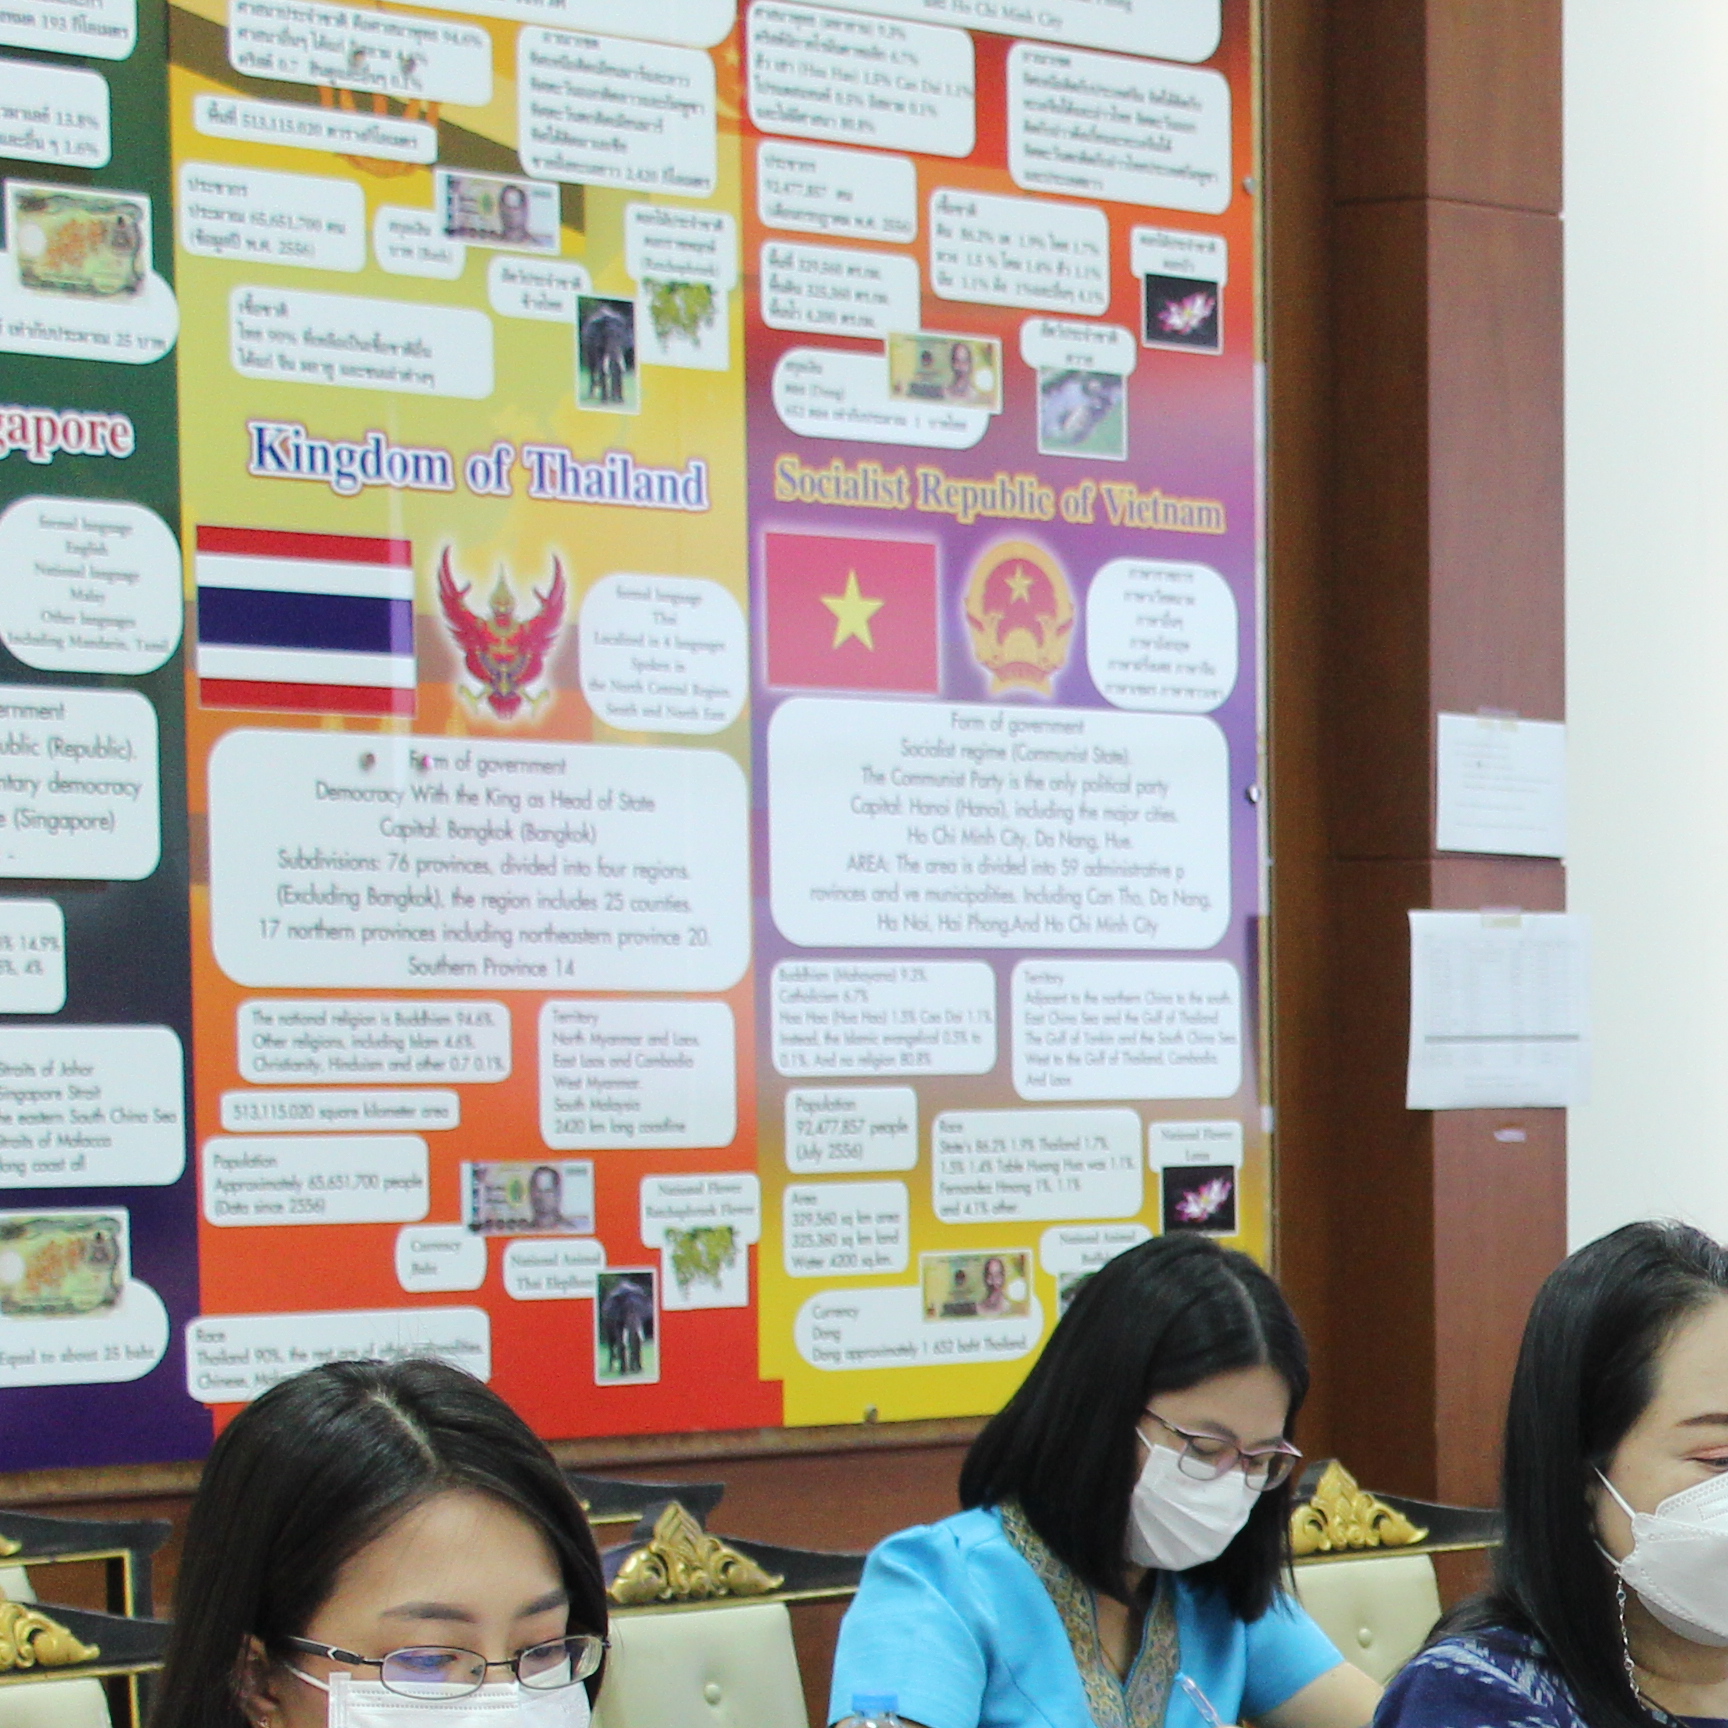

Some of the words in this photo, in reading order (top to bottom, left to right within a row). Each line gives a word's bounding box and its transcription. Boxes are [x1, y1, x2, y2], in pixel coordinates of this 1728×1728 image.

[0, 412, 131, 459] apore
[251, 424, 451, 490] Kingdom
[469, 444, 513, 492] of
[525, 446, 706, 506] Thailand
[777, 458, 906, 508] Socialist
[919, 470, 1054, 520] Republic
[1063, 481, 1093, 520] of
[1101, 486, 1224, 531] Vietnam
[316, 780, 403, 808] Democracy
[485, 786, 521, 813] King
[550, 788, 592, 810] Head
[447, 818, 513, 845] Bangkok
[521, 821, 597, 849] (Bangkok)
[277, 883, 360, 912] (Excluding
[408, 954, 476, 976] Southern
[483, 958, 548, 978] Province
